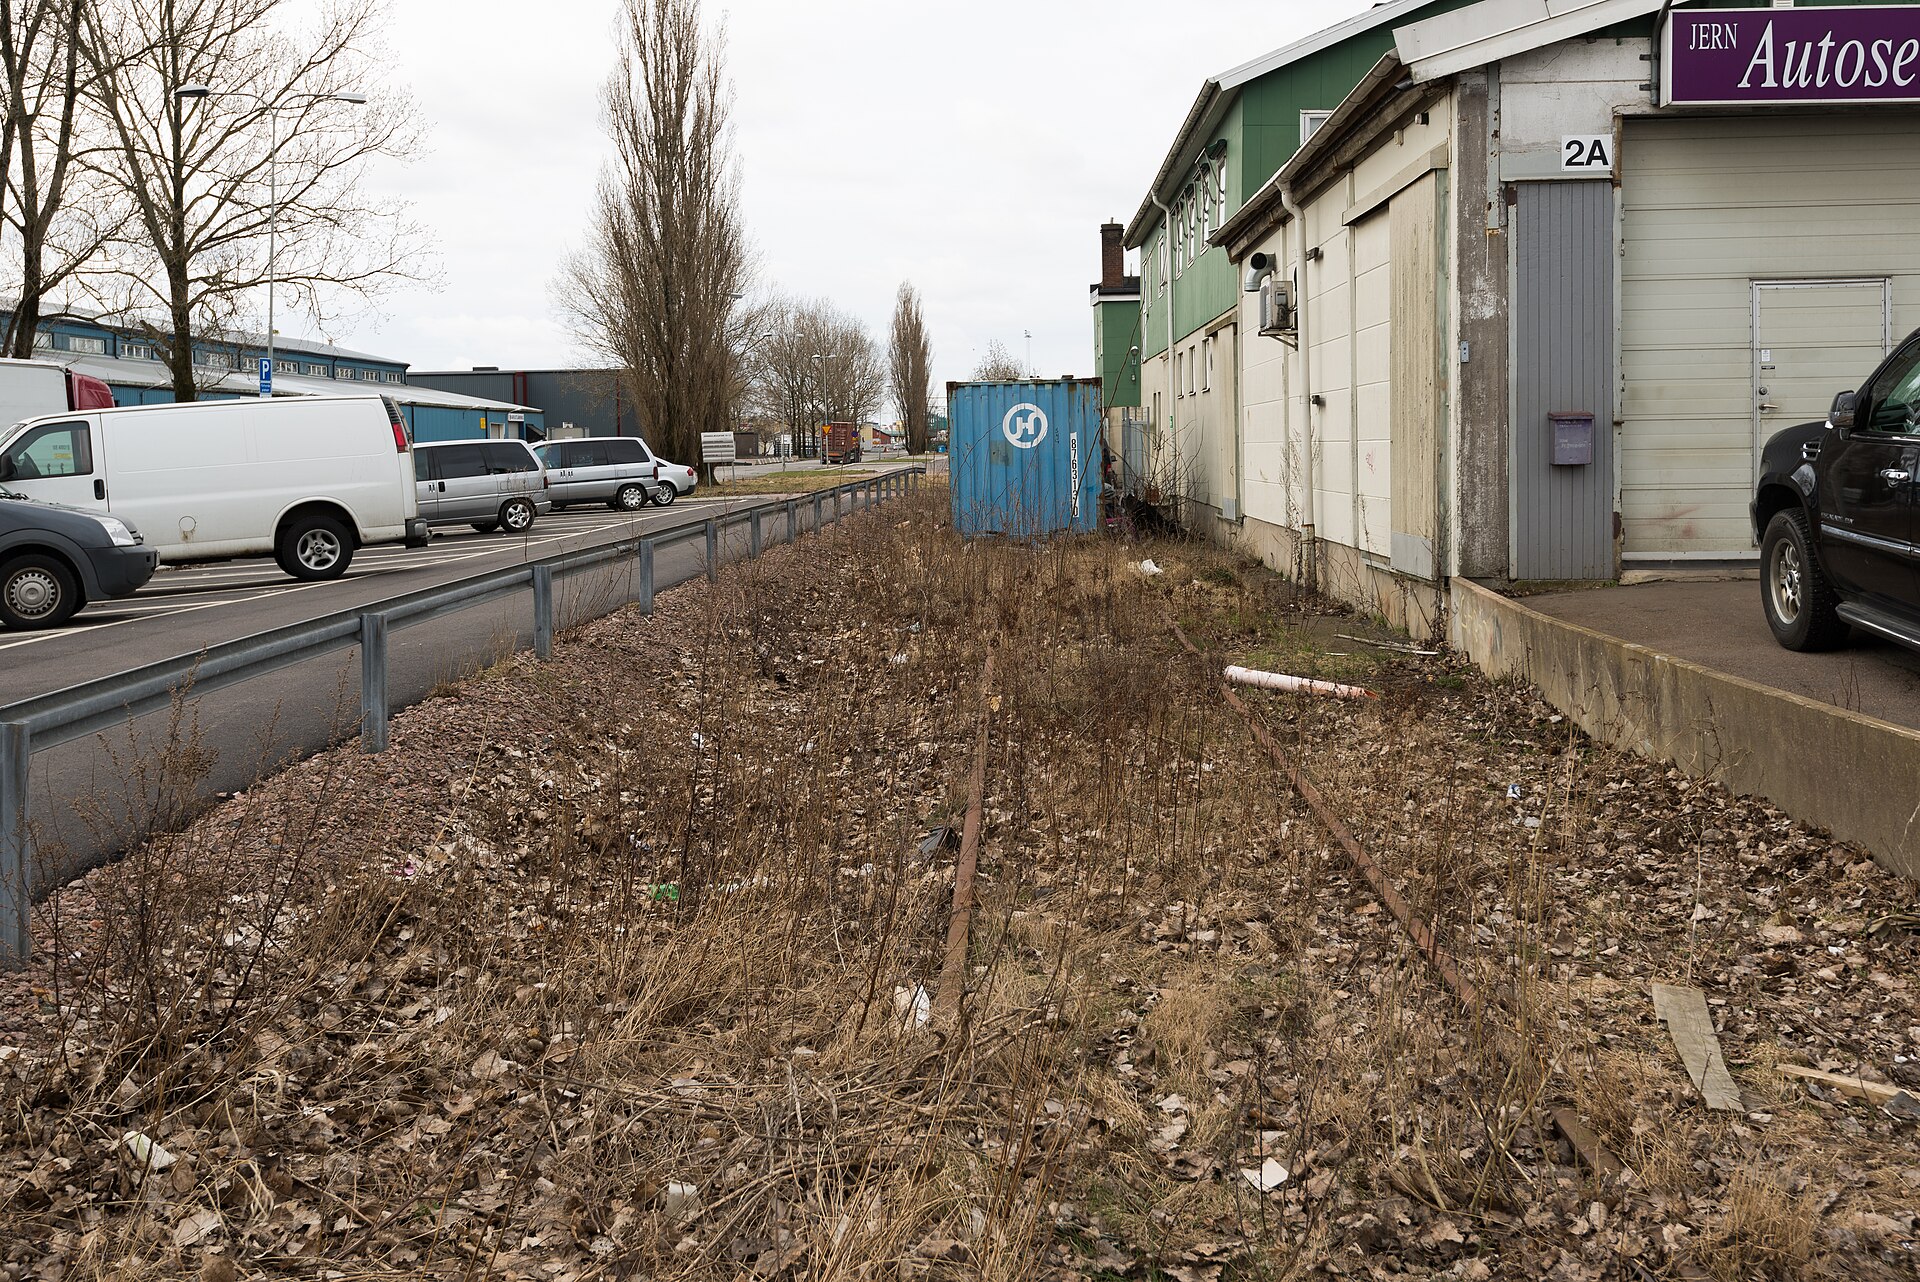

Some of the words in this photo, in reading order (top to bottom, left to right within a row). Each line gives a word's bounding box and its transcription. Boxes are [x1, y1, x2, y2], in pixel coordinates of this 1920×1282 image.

[1689, 23, 1738, 50] JERN
[1737, 19, 1920, 89] Autose
[1564, 139, 1609, 167] 2A
[262, 360, 270, 379] P
